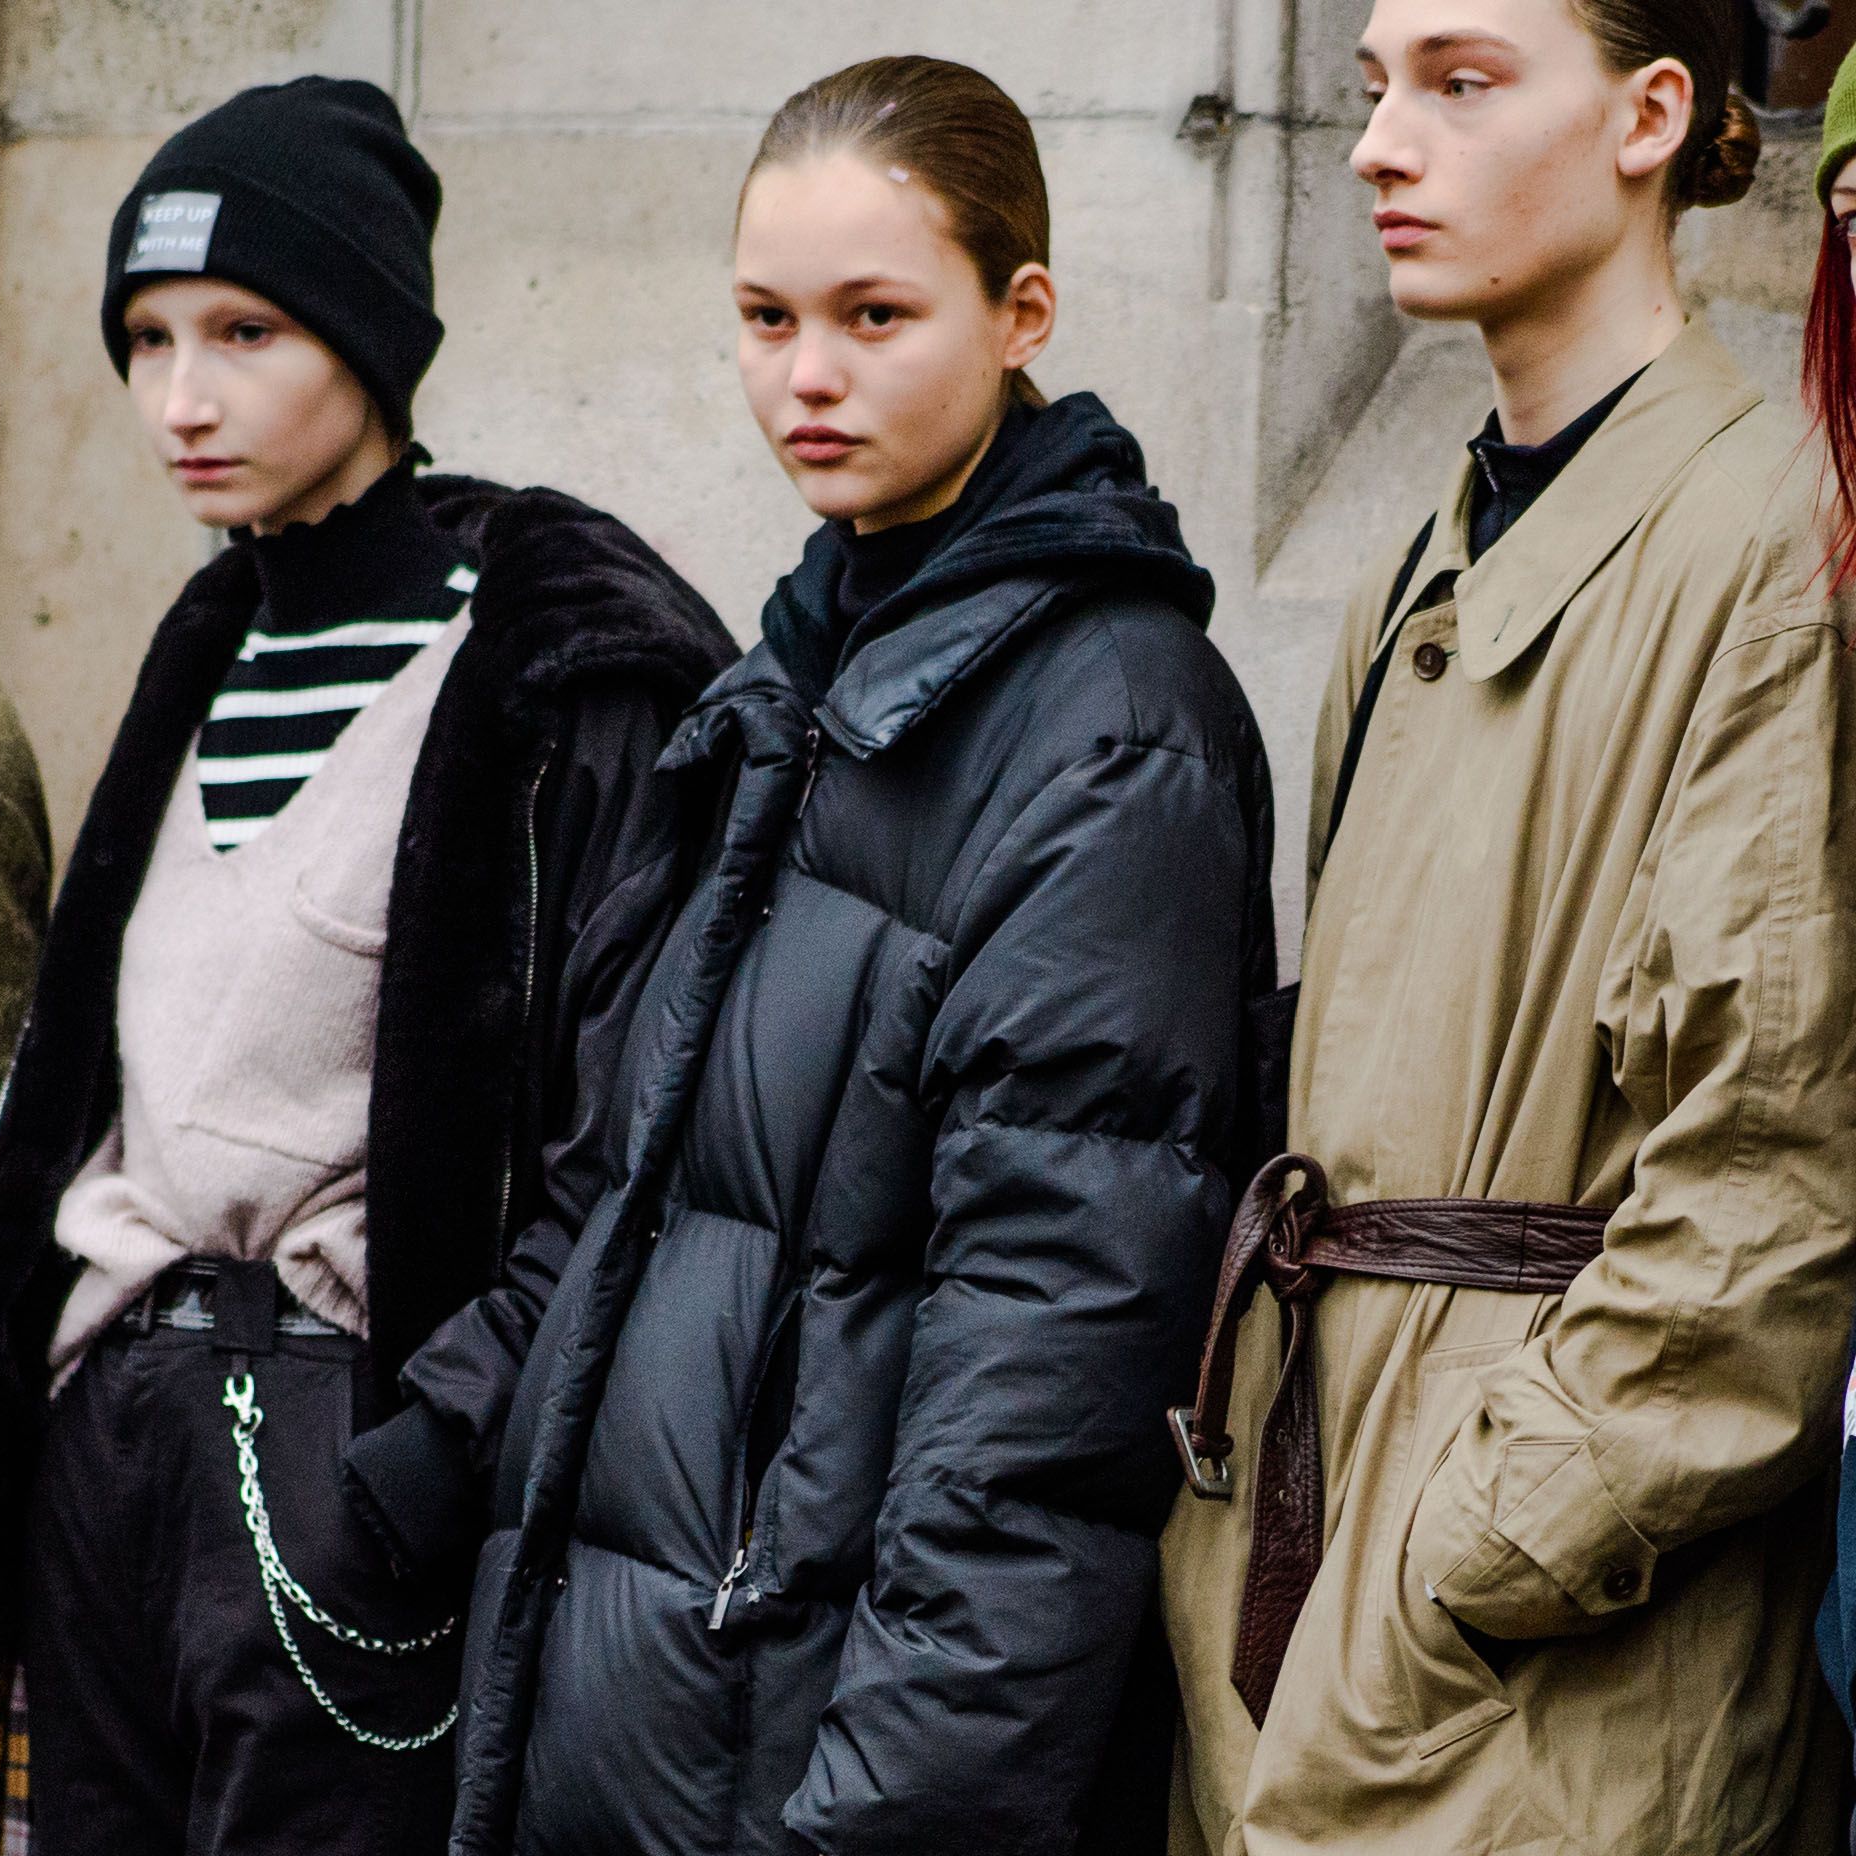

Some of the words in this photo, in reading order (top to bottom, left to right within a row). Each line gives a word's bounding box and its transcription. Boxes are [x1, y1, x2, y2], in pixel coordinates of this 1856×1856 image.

[142, 206, 184, 224] KEEP
[187, 206, 213, 223] UP
[137, 236, 177, 254] WITH
[178, 236, 205, 251] ME
